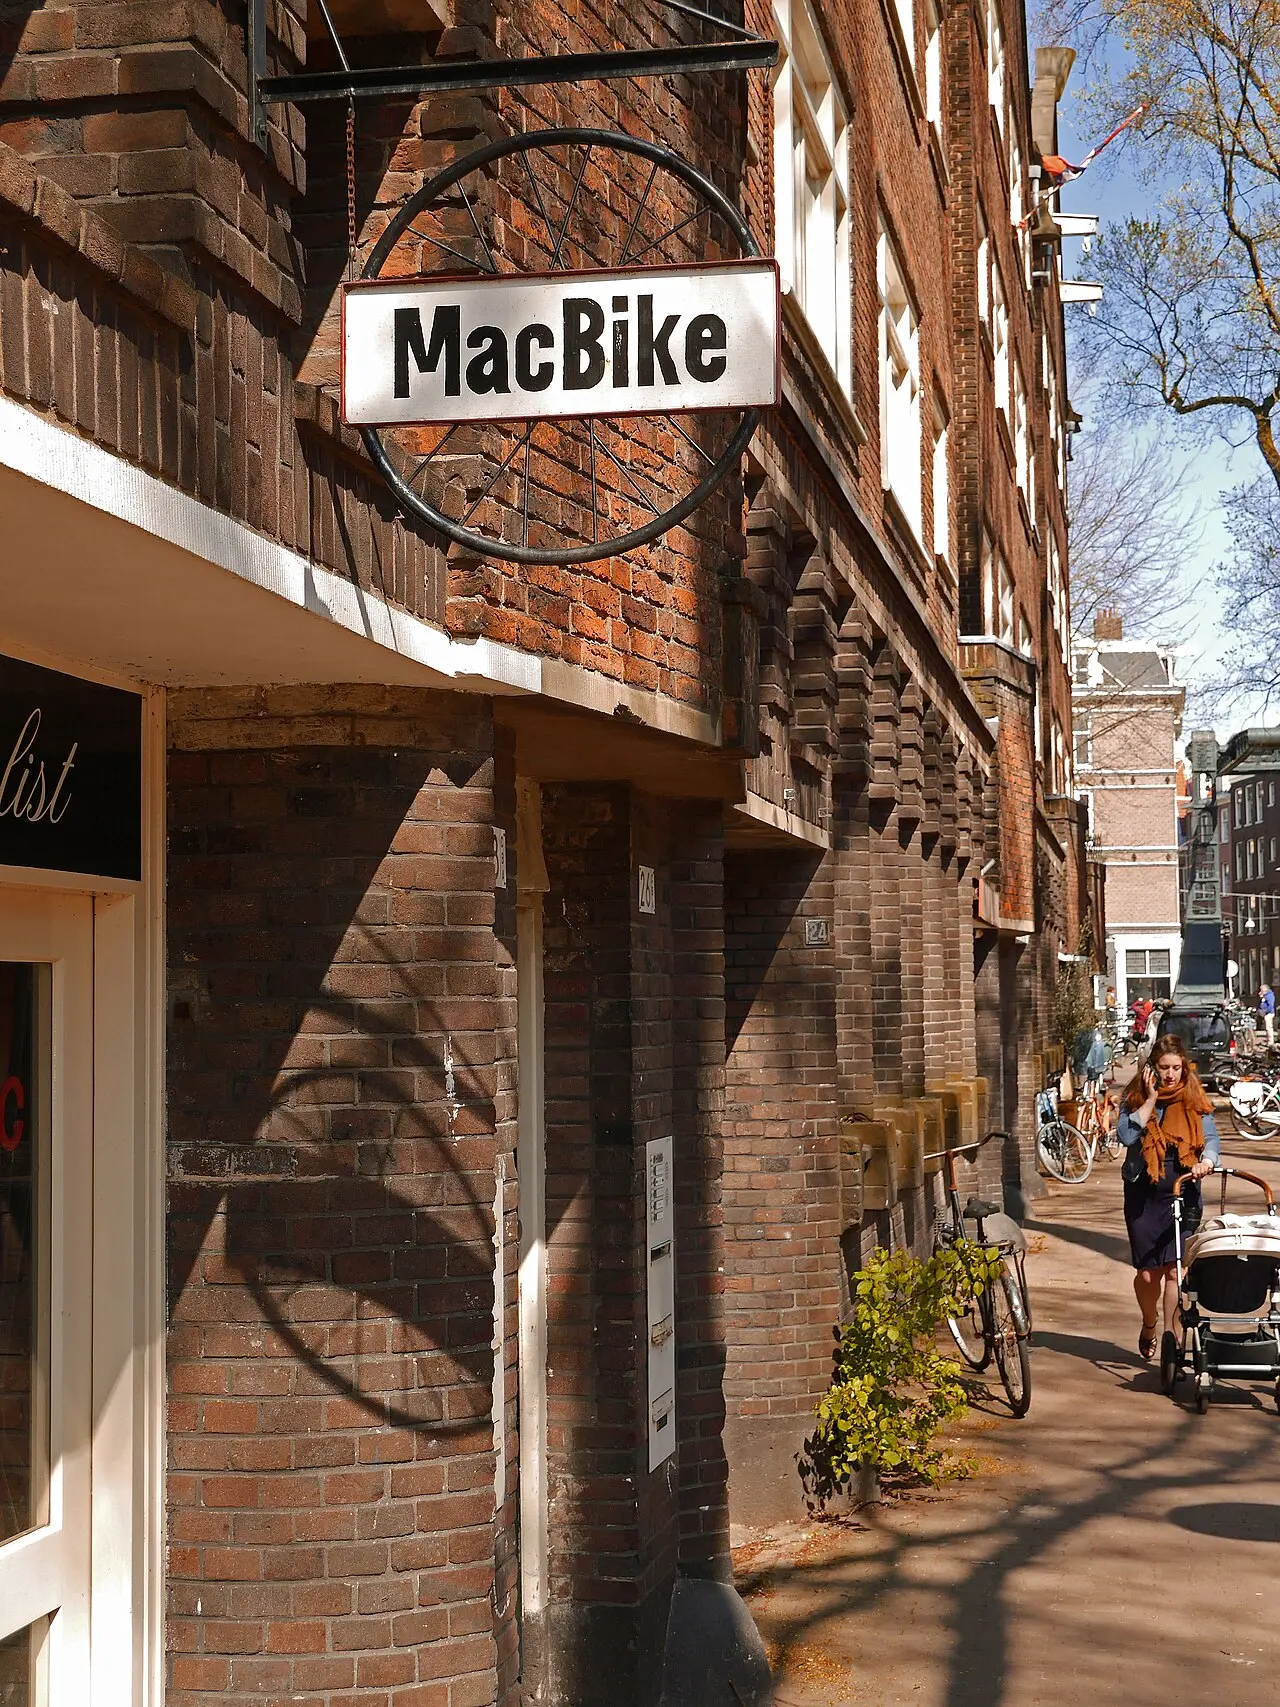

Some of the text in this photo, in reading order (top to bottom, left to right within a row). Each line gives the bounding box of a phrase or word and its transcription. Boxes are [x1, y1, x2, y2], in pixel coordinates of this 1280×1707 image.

[394, 294, 727, 399] MacBike
[640, 870, 650, 908] 26
[808, 921, 828, 942] 24
